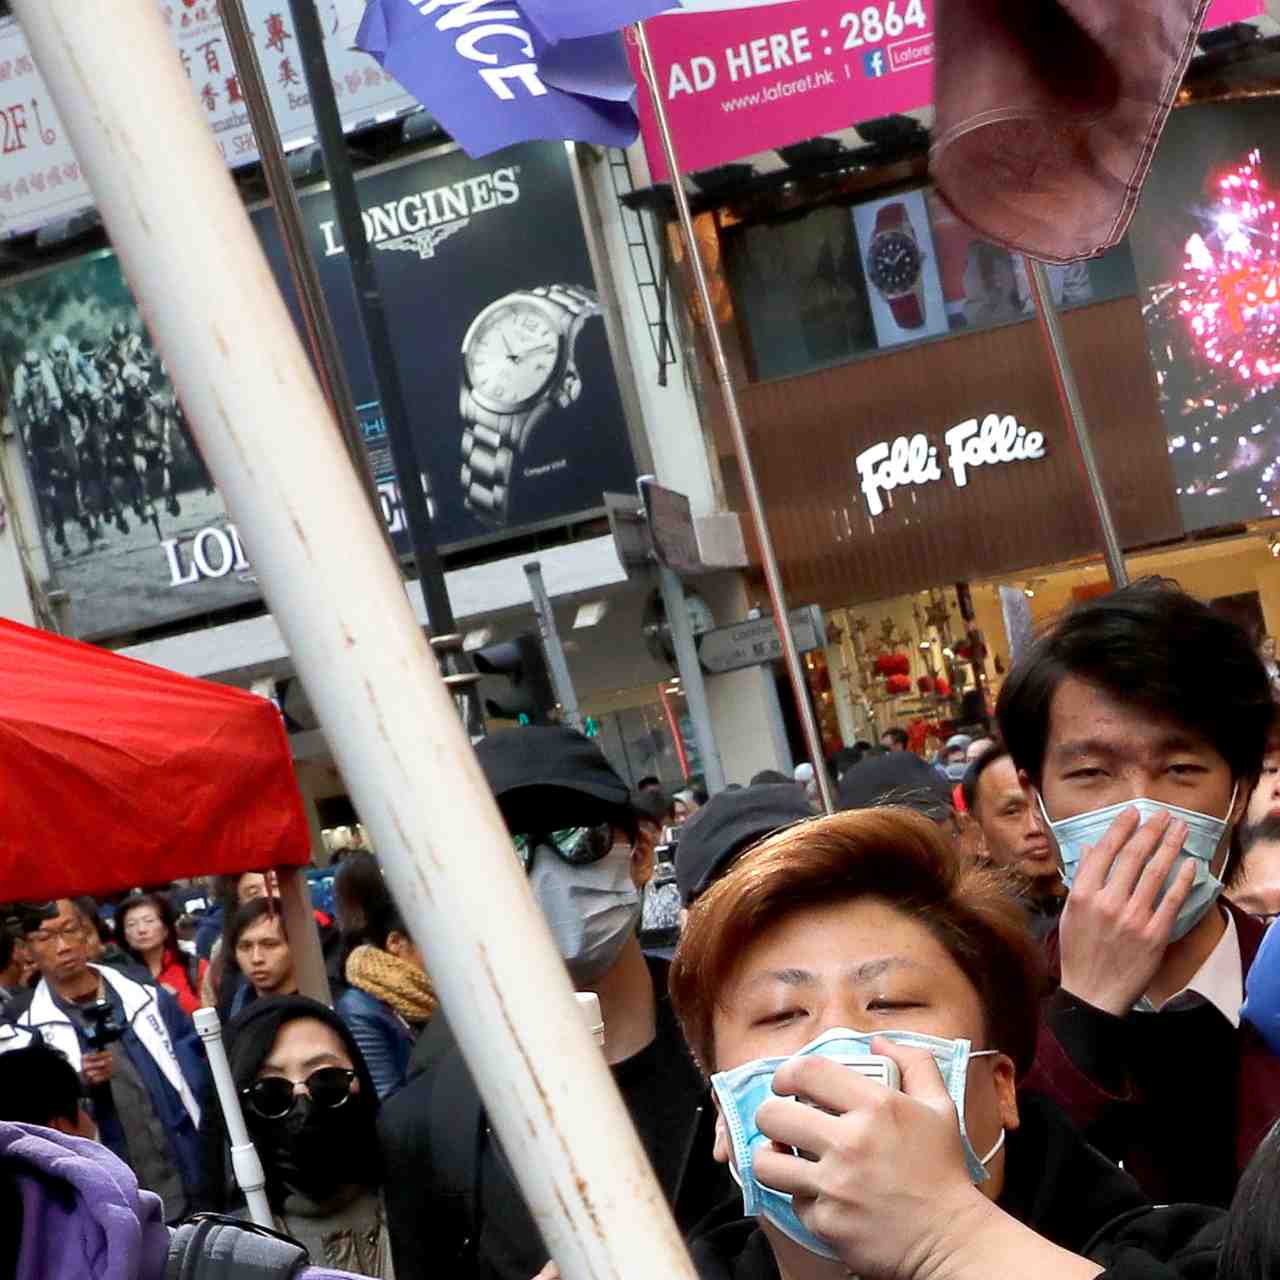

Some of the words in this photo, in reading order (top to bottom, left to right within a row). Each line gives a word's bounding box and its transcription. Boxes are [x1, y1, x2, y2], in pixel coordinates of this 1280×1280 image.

[667, 56, 716, 100] AD
[725, 26, 812, 82] HERE
[839, 0, 926, 50] 2864
[720, 68, 835, 113] www.laforet.hk
[319, 166, 521, 257] LNGINES
[856, 433, 942, 516] Folli
[945, 413, 1046, 487] Follie
